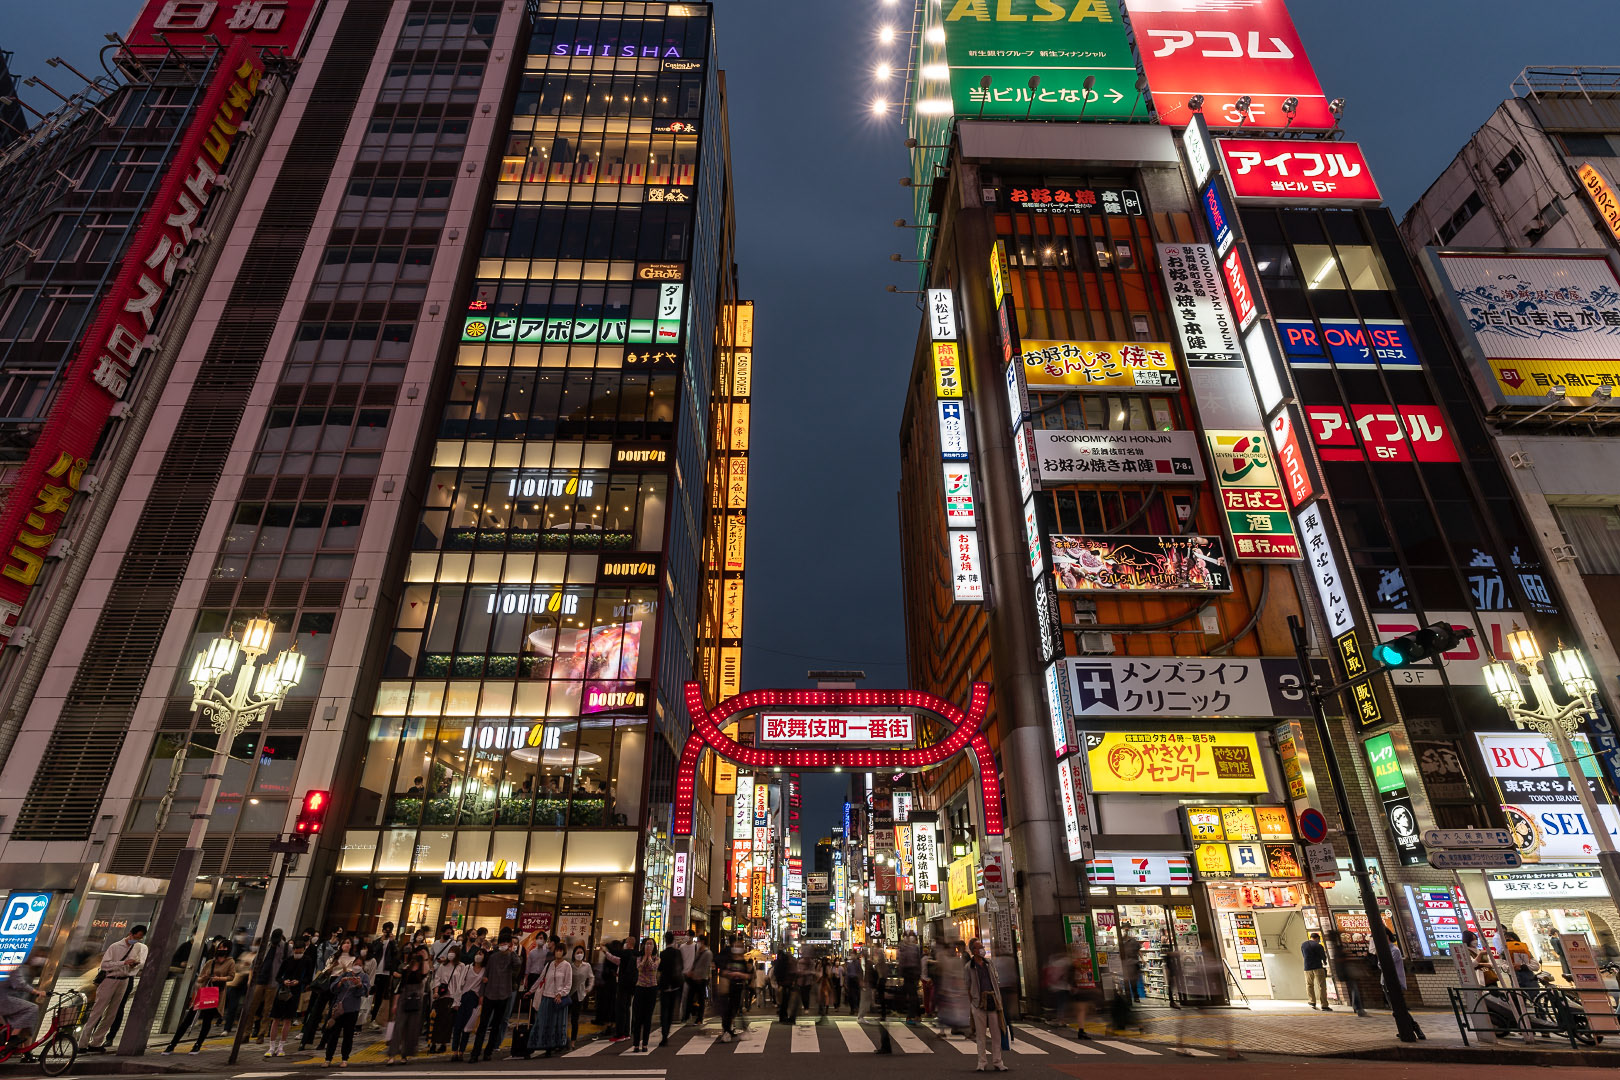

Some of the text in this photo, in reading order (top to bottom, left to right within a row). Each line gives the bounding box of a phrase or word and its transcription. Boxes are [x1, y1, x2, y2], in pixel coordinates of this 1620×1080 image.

[554, 44, 681, 58] SHISHA
[1147, 29, 1295, 60] アコム
[969, 86, 1099, 103] 当ビルとなり
[1228, 151, 1361, 178] アイフル
[1271, 181, 1338, 193] 当ビル 5F
[1010, 188, 1097, 205] お好み焼
[1125, 199, 1138, 208] 8F
[1207, 188, 1224, 231] PROMISE
[639, 267, 682, 280] GROVE
[1196, 246, 1235, 351] OKONOMIYAKI HONJIN
[1230, 265, 1251, 316] アイフル
[664, 285, 680, 316] ダーツ
[1168, 256, 1208, 350] お好み焼き本陣
[934, 292, 951, 337] 小松ビル
[1481, 310, 1620, 327] だんまや水産
[491, 319, 651, 342] ビアポンバー
[1287, 328, 1403, 347] PROMISE
[1024, 344, 1081, 366] お好み
[1119, 345, 1168, 368] 焼き
[1360, 348, 1407, 359] プロミス
[1046, 351, 1113, 377] もんじゃ
[1083, 362, 1123, 383] たこ
[1161, 373, 1178, 385] 7F
[1503, 371, 1520, 381] B1
[1310, 412, 1443, 442] アイフル
[1050, 434, 1172, 444] OKONOMIYAKI HONJIN
[618, 450, 666, 462] DOUTOR
[1375, 446, 1398, 459] 5F
[1044, 458, 1155, 474] お好み焼き本陣
[1283, 444, 1304, 490] アコム
[1226, 490, 1283, 508] たばこ
[1296, 486, 1306, 501] 3F
[1245, 513, 1273, 532] 酒
[958, 534, 973, 572] お好み焼
[1158, 541, 1215, 550] サルサラティーノ
[604, 562, 656, 576] DOUTOR
[1100, 570, 1178, 586] SALSA LATINO
[1304, 513, 1347, 627] 東京ぶらんど
[1204, 572, 1222, 586] 4F
[1342, 638, 1362, 672] 買取
[1120, 661, 1249, 685] メンズライフ
[1403, 672, 1425, 684] 3F
[588, 691, 645, 707] DOUTOR
[1123, 690, 1231, 713] クリニック
[1355, 683, 1376, 720] 販売
[767, 718, 909, 739] 歌舞伎町一番街
[1087, 735, 1102, 746] 2F
[1142, 744, 1201, 764] やきとり
[1215, 748, 1248, 761] やきとり
[1370, 745, 1393, 763] レイク
[1491, 747, 1547, 769] BUY
[1147, 764, 1210, 783] センター
[1218, 761, 1250, 774] 専門店
[1376, 761, 1400, 777] ALSA
[1197, 825, 1216, 834] ブル
[443, 859, 518, 880] DOUTOR
[676, 855, 686, 895] 劇場通り
[1504, 881, 1589, 891] 東京ぶらんど
[32, 900, 46, 908] 24h
[3, 902, 30, 931] P
[1098, 914, 1116, 926] SIM
[12, 922, 36, 931] 400台
